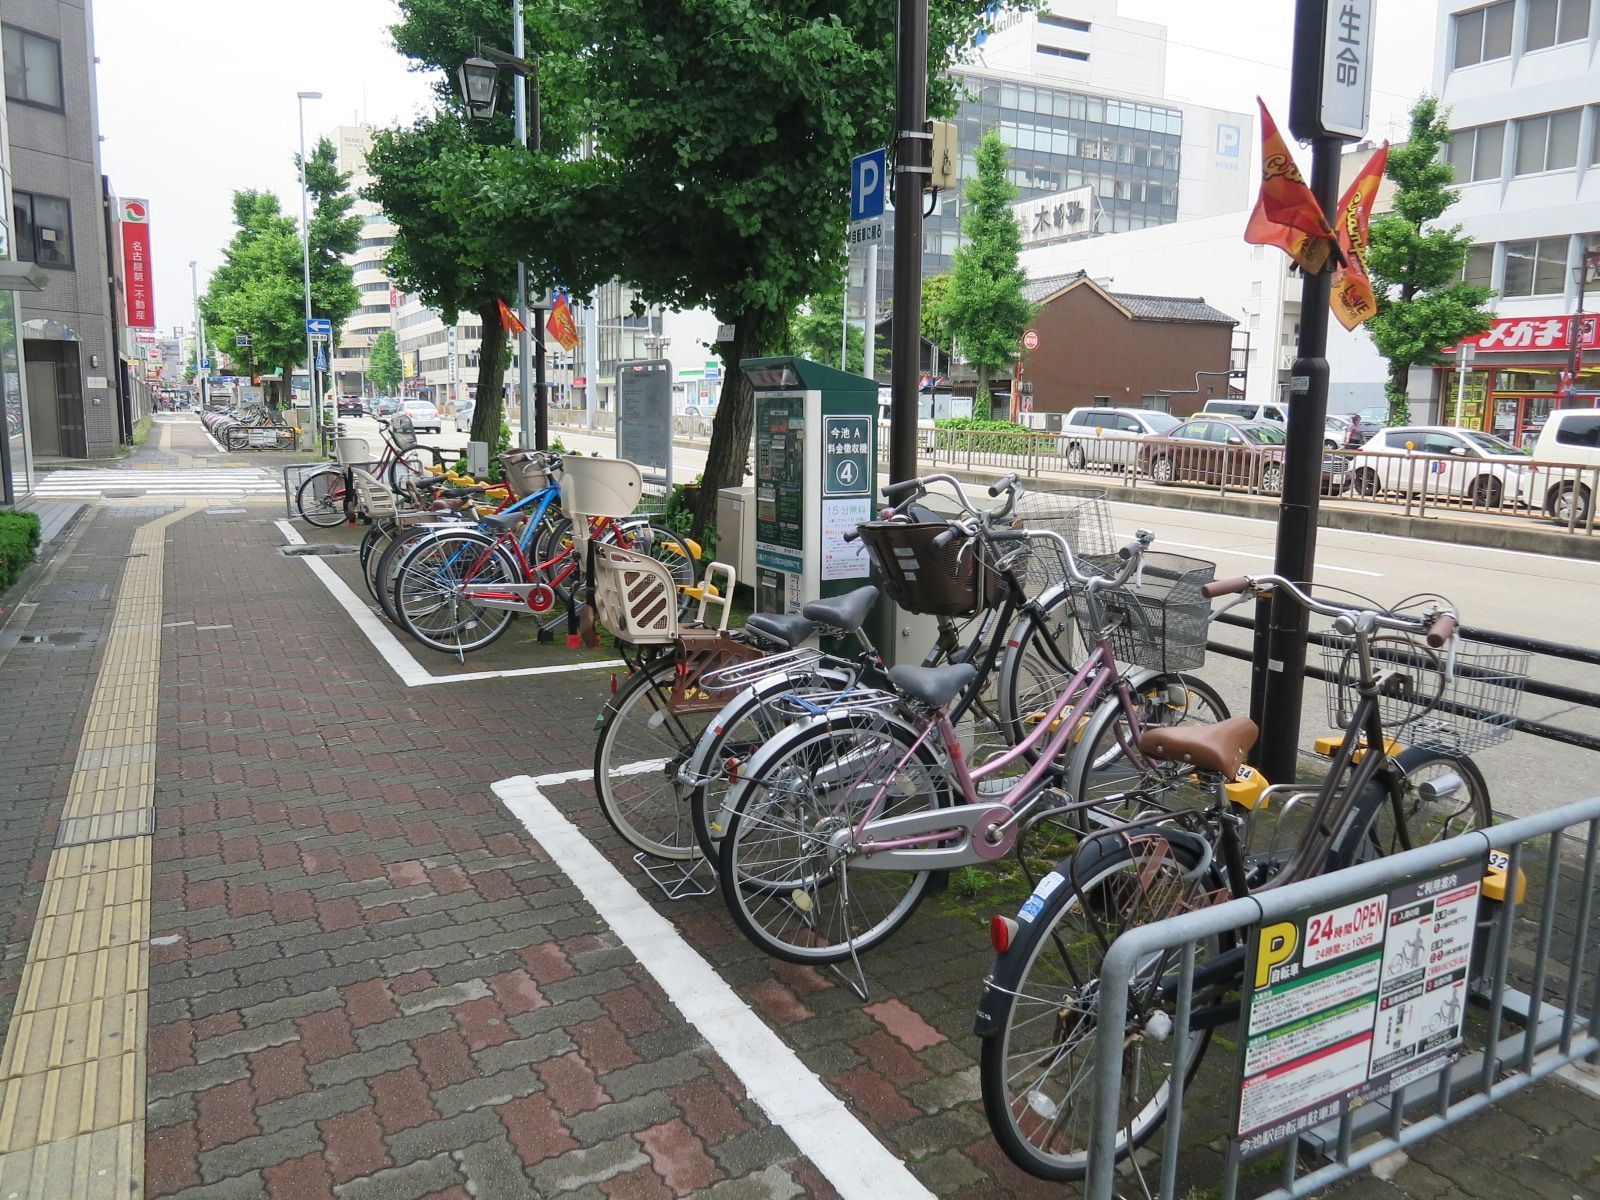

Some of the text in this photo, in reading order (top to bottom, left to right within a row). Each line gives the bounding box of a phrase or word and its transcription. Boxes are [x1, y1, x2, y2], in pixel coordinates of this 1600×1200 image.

[859, 160, 879, 213] P
[852, 225, 882, 244] 自転車に限る
[132, 241, 146, 320] 名古屋第一不動産
[1479, 320, 1562, 347] メガネ
[830, 427, 861, 439] 今池 A
[827, 505, 866, 516] 15分無料
[1237, 767, 1251, 778] 34
[1489, 854, 1507, 869] 32
[1254, 920, 1299, 990] P
[1271, 962, 1300, 984] 自転車
[1240, 1100, 1340, 1156] 今池駅自転車駐車場
